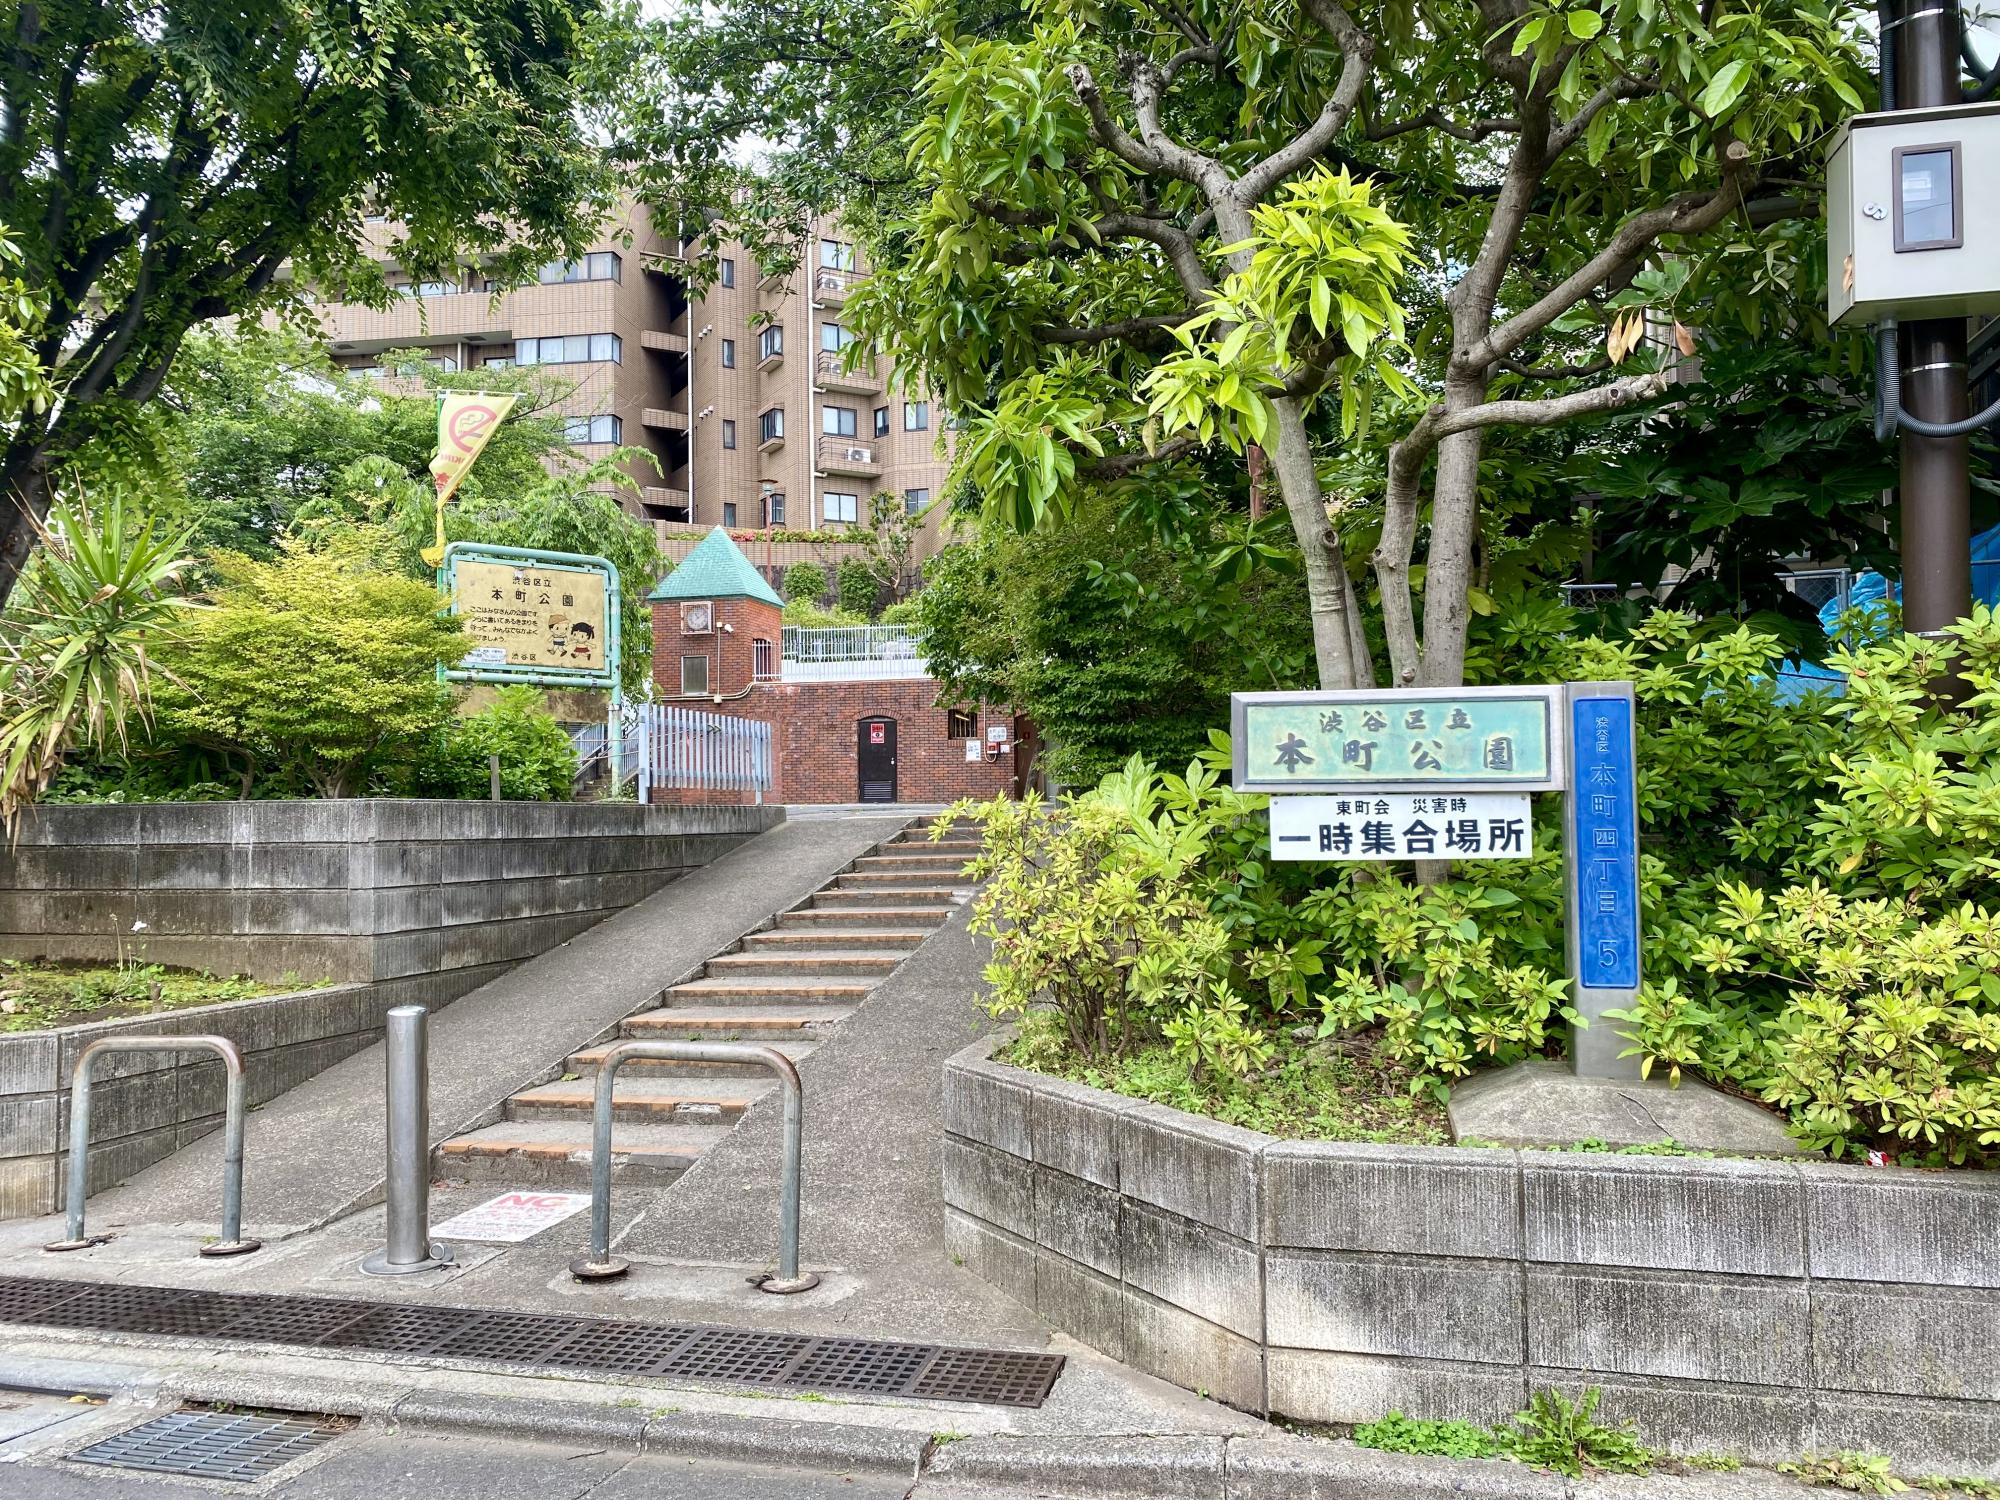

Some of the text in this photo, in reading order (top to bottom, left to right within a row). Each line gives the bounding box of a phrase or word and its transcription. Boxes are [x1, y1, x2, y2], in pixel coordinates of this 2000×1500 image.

[512, 576, 552, 588] 渋谷区立
[491, 588, 574, 607] 本町公園
[511, 653, 537, 661] 渋谷区
[1319, 708, 1472, 734] 渋谷区立
[1273, 732, 1514, 774] 本町公園
[1336, 797, 1468, 816] 東町会 災害時
[1278, 818, 1525, 854] 一時集合場所
[1590, 716, 1619, 969] 渋谷区 本町四丁目 5
